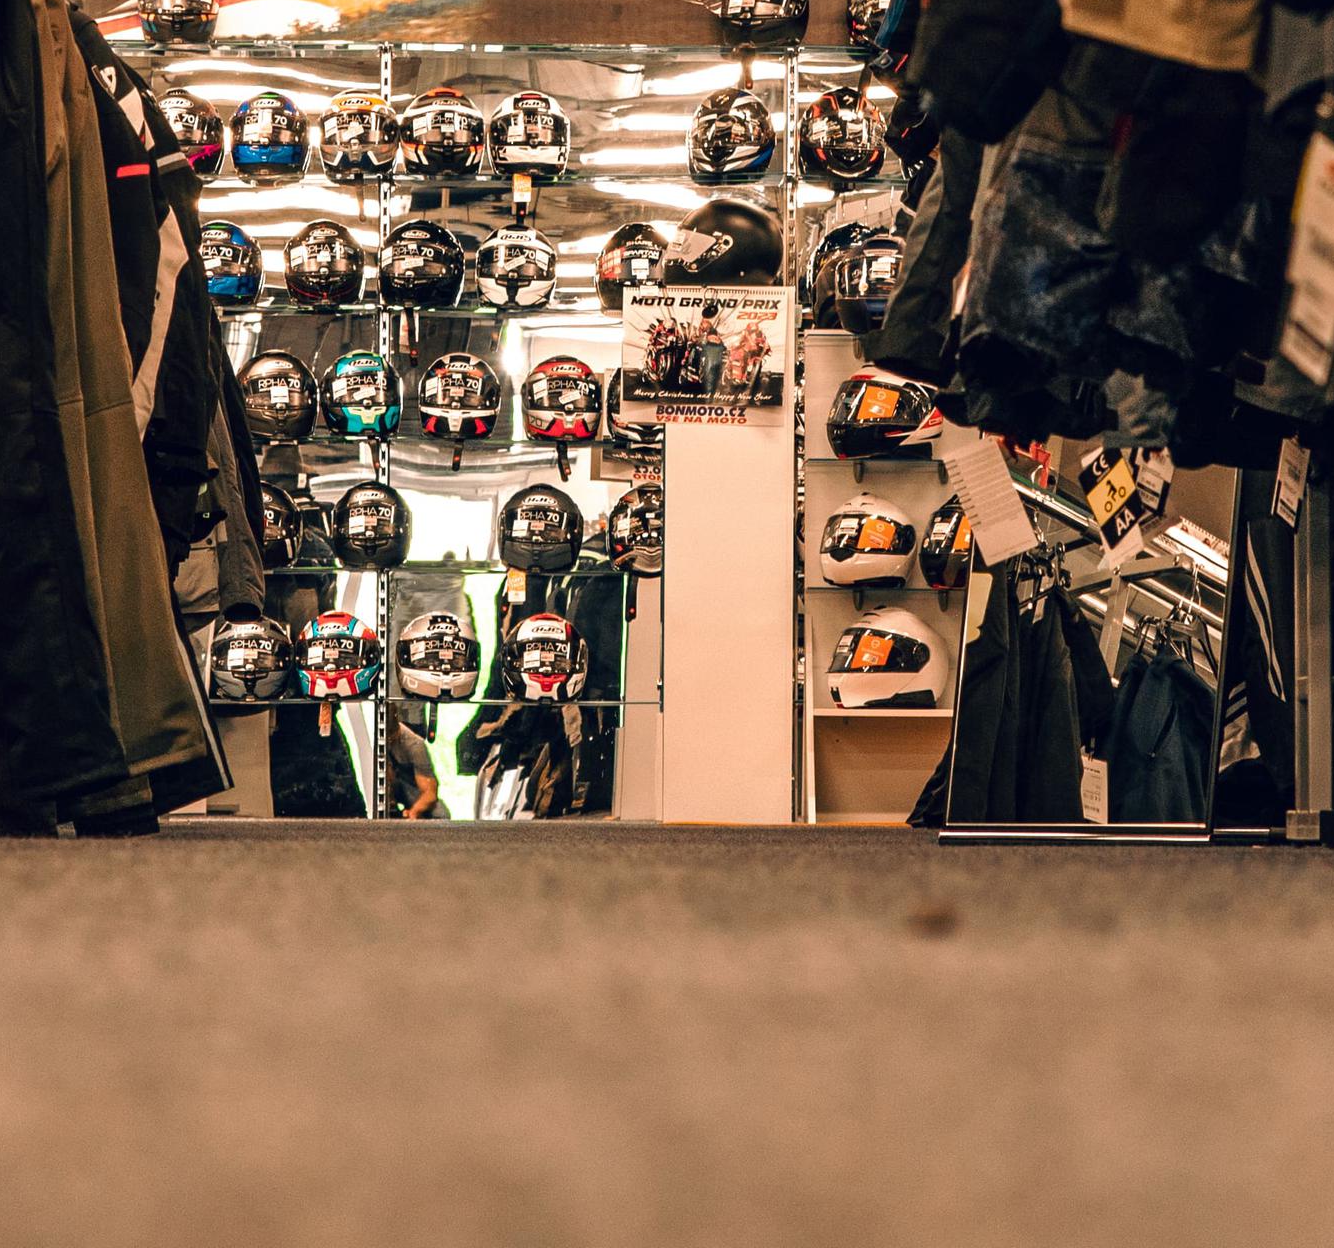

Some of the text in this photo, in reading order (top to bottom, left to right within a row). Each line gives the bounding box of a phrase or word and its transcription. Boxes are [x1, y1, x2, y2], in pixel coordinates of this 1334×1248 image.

[182, 115, 195, 124] 70
[274, 115, 288, 125] 70
[541, 116, 554, 125] 70
[219, 246, 233, 257] 70
[421, 246, 434, 257] 70
[524, 250, 536, 259] 70
[630, 295, 675, 307] MOTO
[742, 299, 781, 310] PRIX
[736, 311, 778, 320] 2023
[258, 378, 300, 389] RPHA 70
[467, 379, 479, 389] 70
[547, 381, 575, 391] RPHA
[658, 390, 694, 398] Christmas
[696, 391, 711, 399] and
[713, 392, 735, 401] Happy
[737, 392, 752, 400] New
[655, 405, 748, 417] BONMOTO.CZ
[1092, 453, 1109, 476] CE
[378, 507, 391, 517] 70
[547, 513, 560, 522] 70
[1115, 508, 1136, 537] AA
[340, 639, 354, 649] 70
[454, 642, 466, 651] 70
[525, 643, 568, 653] RPHA 70
